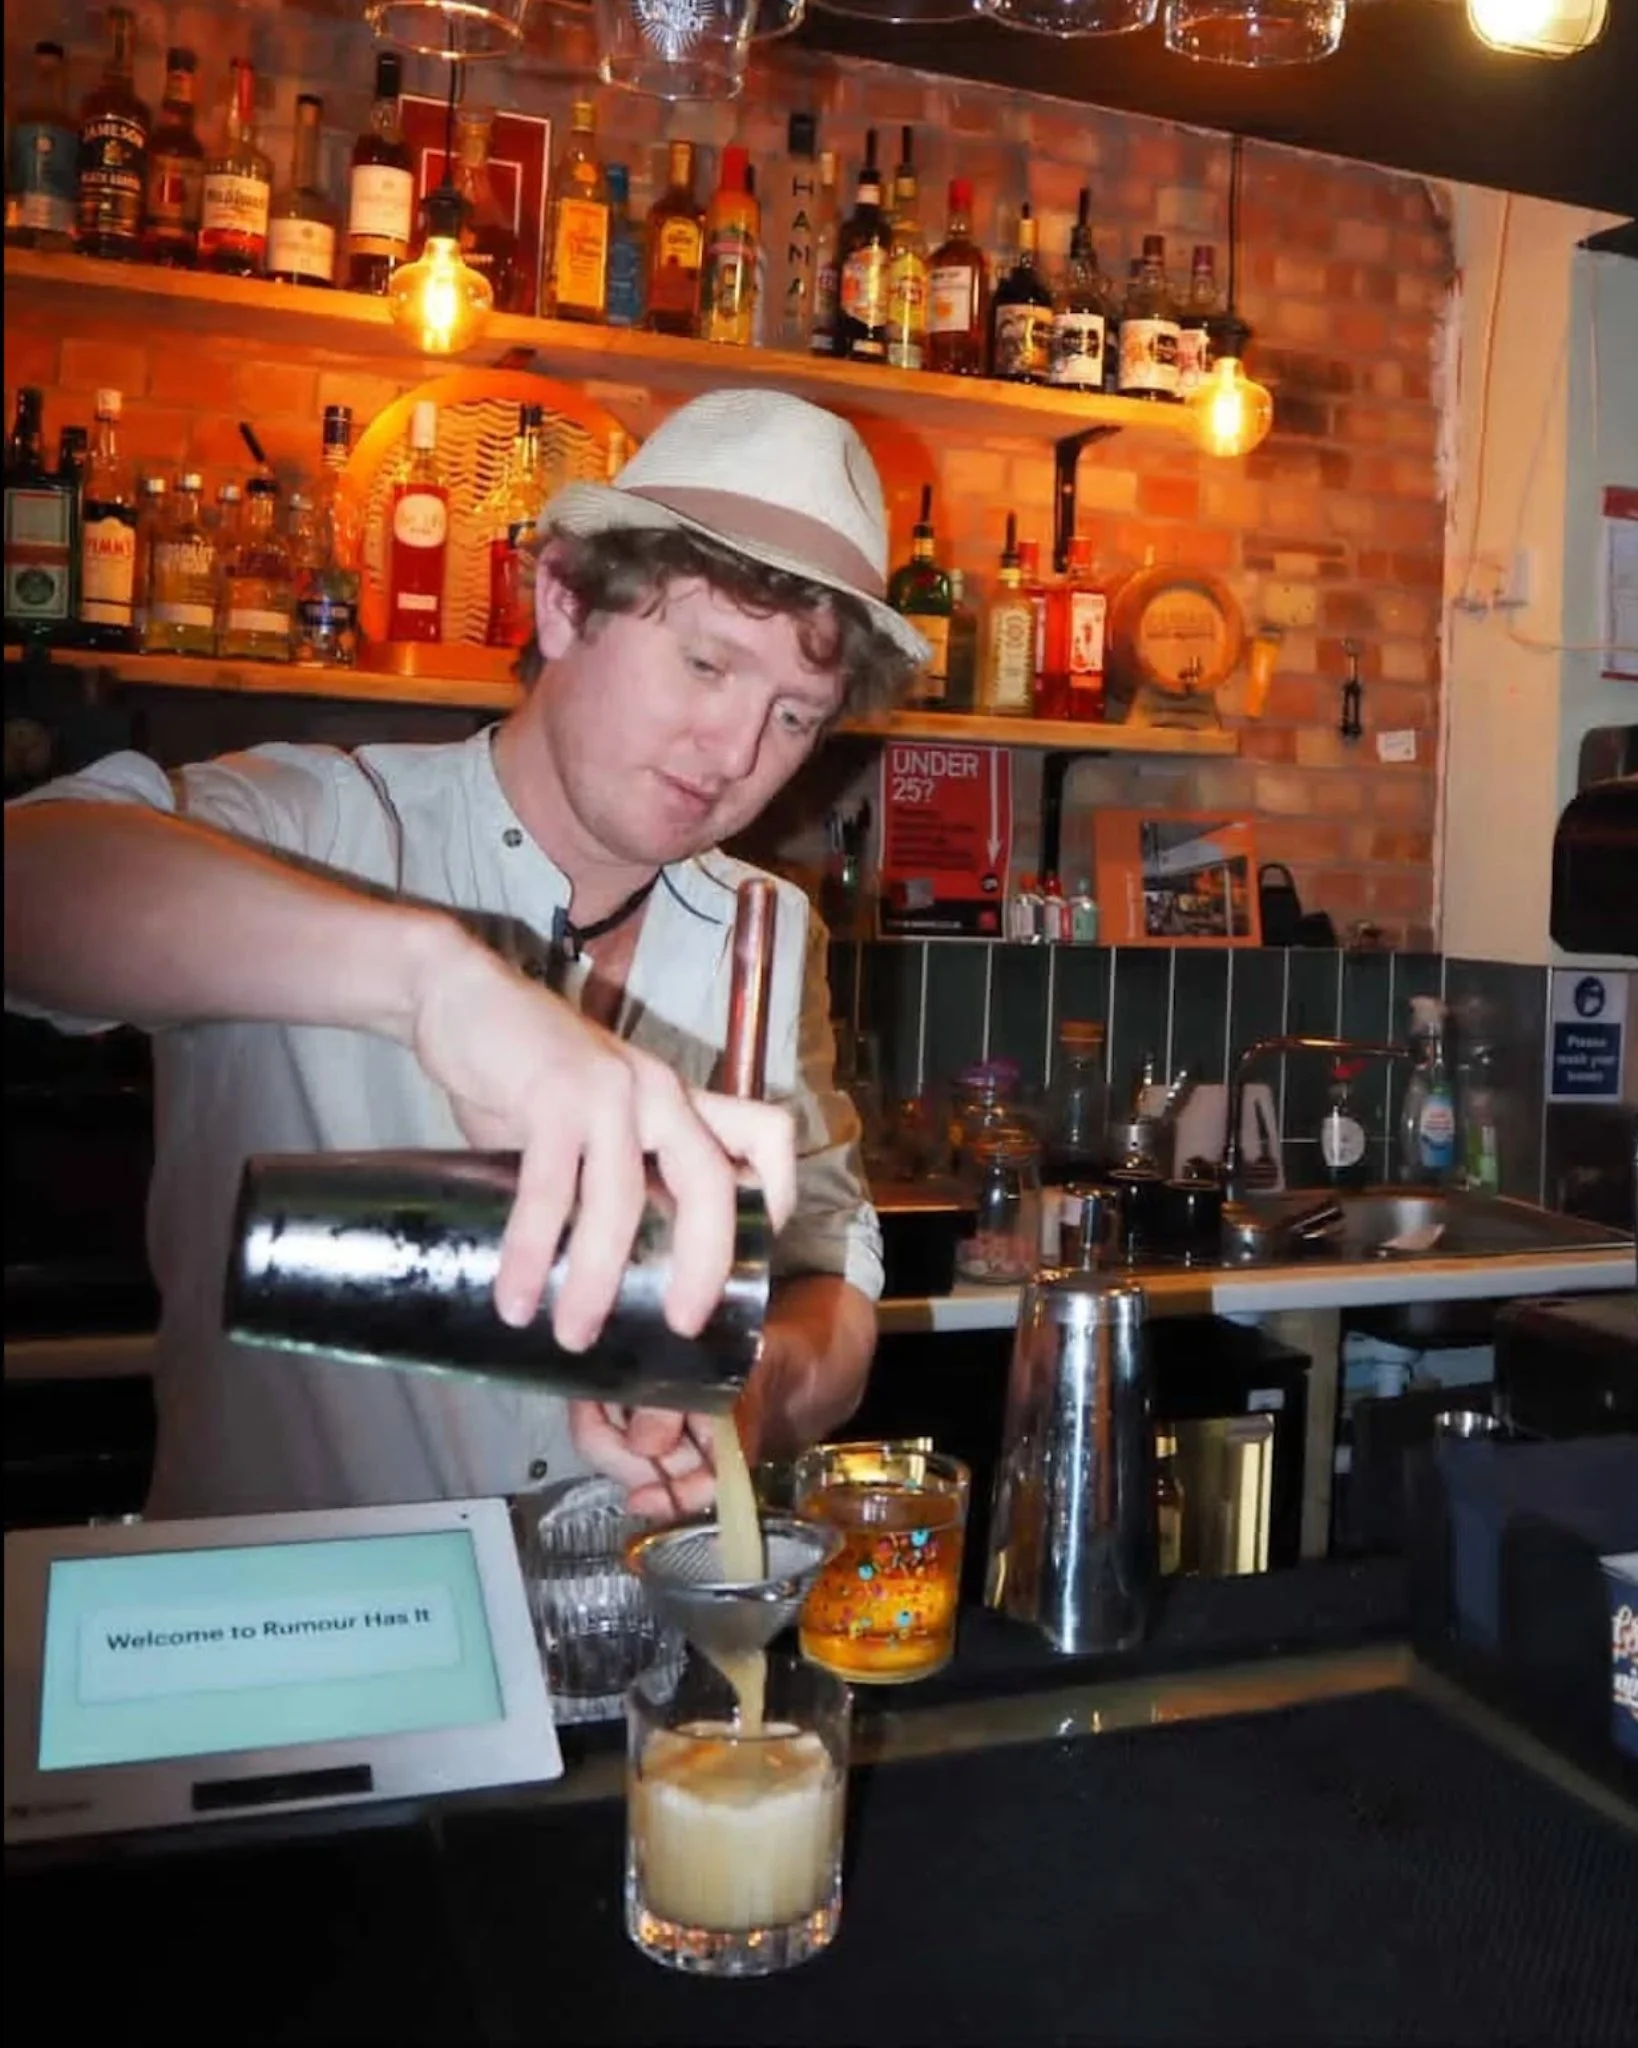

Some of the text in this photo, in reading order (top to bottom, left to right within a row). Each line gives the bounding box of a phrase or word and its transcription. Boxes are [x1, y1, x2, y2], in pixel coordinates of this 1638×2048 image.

[892, 750, 979, 779] UNDER
[892, 776, 936, 802] 25?
[107, 1606, 431, 1652] Welcome to Rumour Has It
